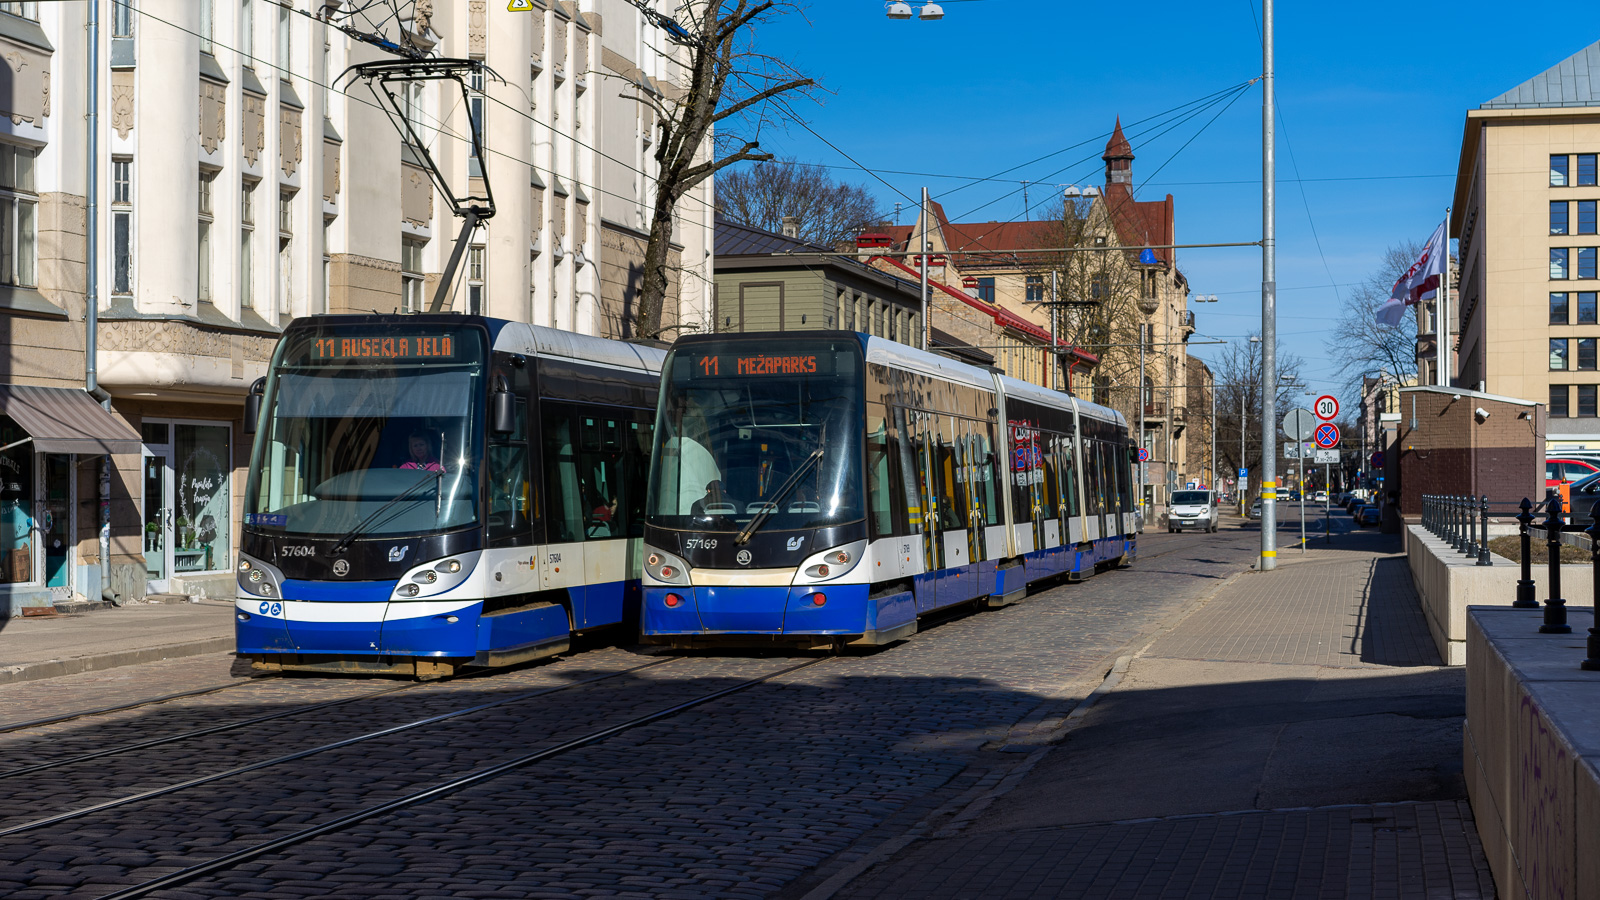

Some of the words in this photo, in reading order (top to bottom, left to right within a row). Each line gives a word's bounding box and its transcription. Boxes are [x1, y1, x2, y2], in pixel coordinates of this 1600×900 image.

[315, 338, 335, 358] 11
[341, 337, 409, 359] AUSEKĻA
[416, 337, 451, 356] IELA
[699, 356, 719, 376] 11
[737, 354, 817, 375] MEŽAPARKS
[1320, 401, 1333, 415] 30
[281, 545, 316, 557] 57604
[685, 538, 718, 550] 57169
